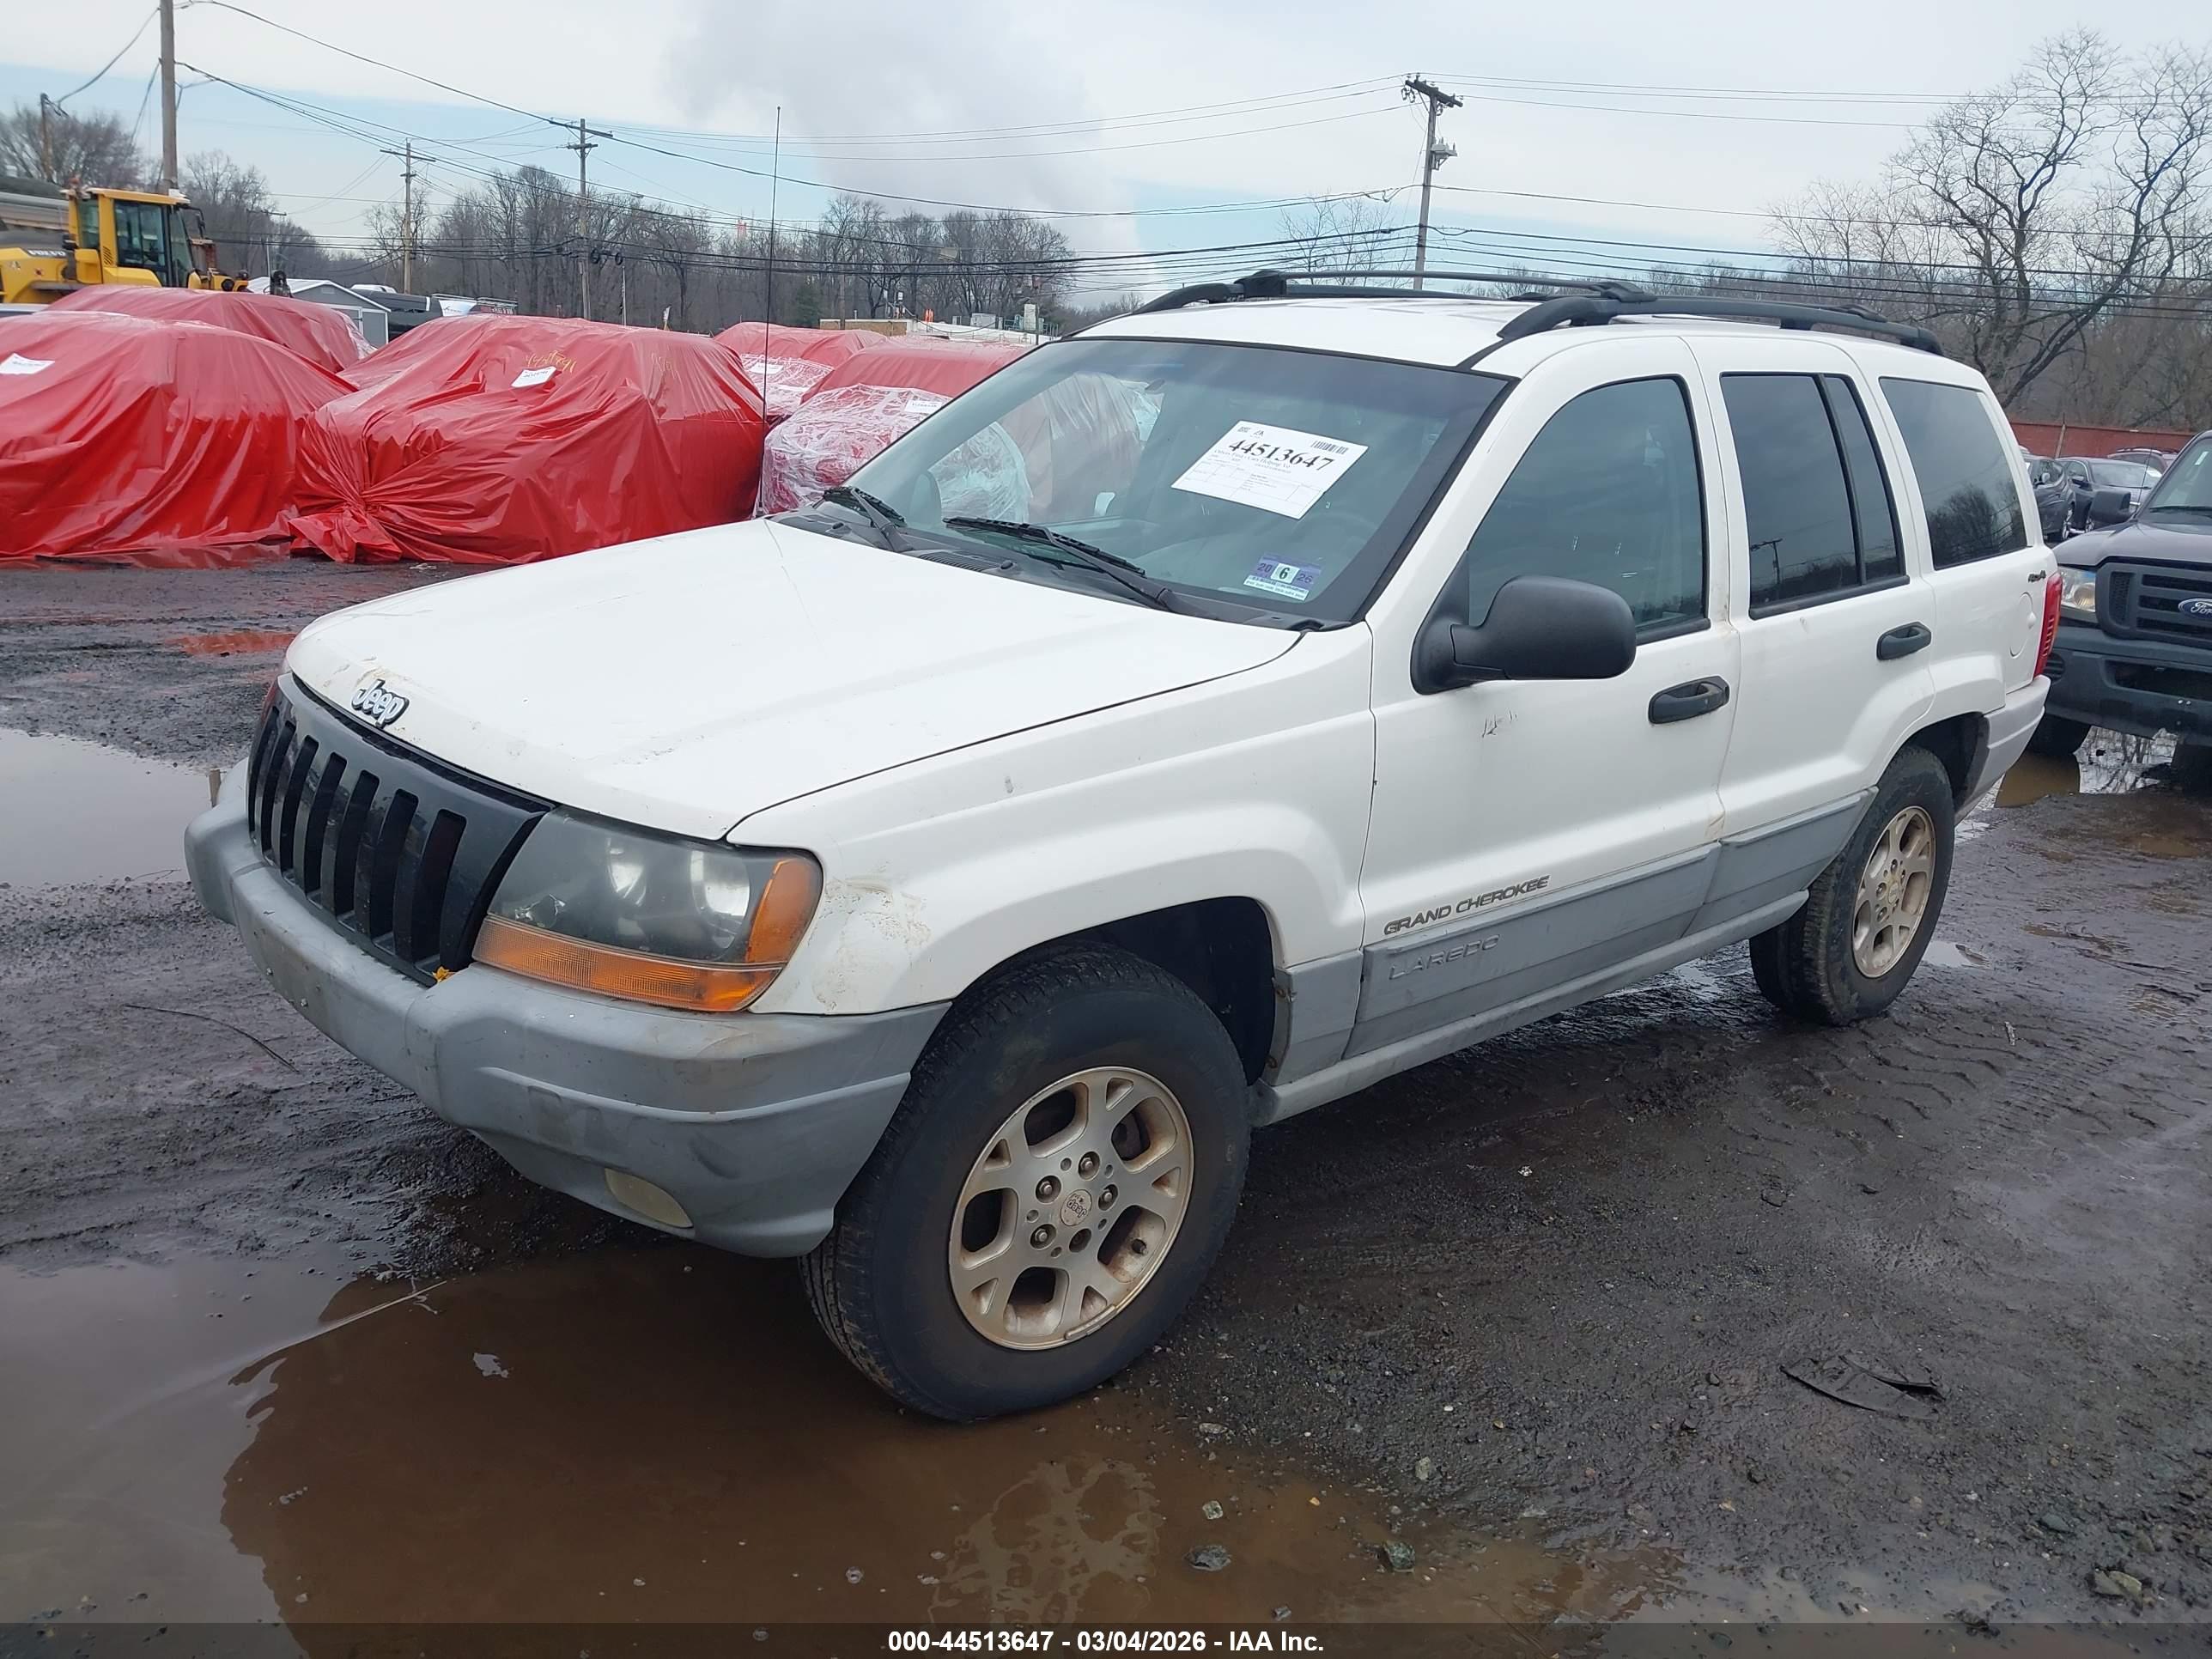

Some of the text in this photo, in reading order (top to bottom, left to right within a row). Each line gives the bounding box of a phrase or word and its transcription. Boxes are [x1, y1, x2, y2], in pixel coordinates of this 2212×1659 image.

[1228, 440, 1335, 471] 44513647
[1257, 562, 1273, 573] 20
[1279, 567, 1290, 580] 6
[2190, 601, 2212, 617] For
[351, 678, 410, 729] Jeep
[1383, 875, 1550, 935] GRAND CHEROKEE
[1389, 933, 1501, 980] LAREDO
[1066, 1199, 1087, 1218] Jeep
